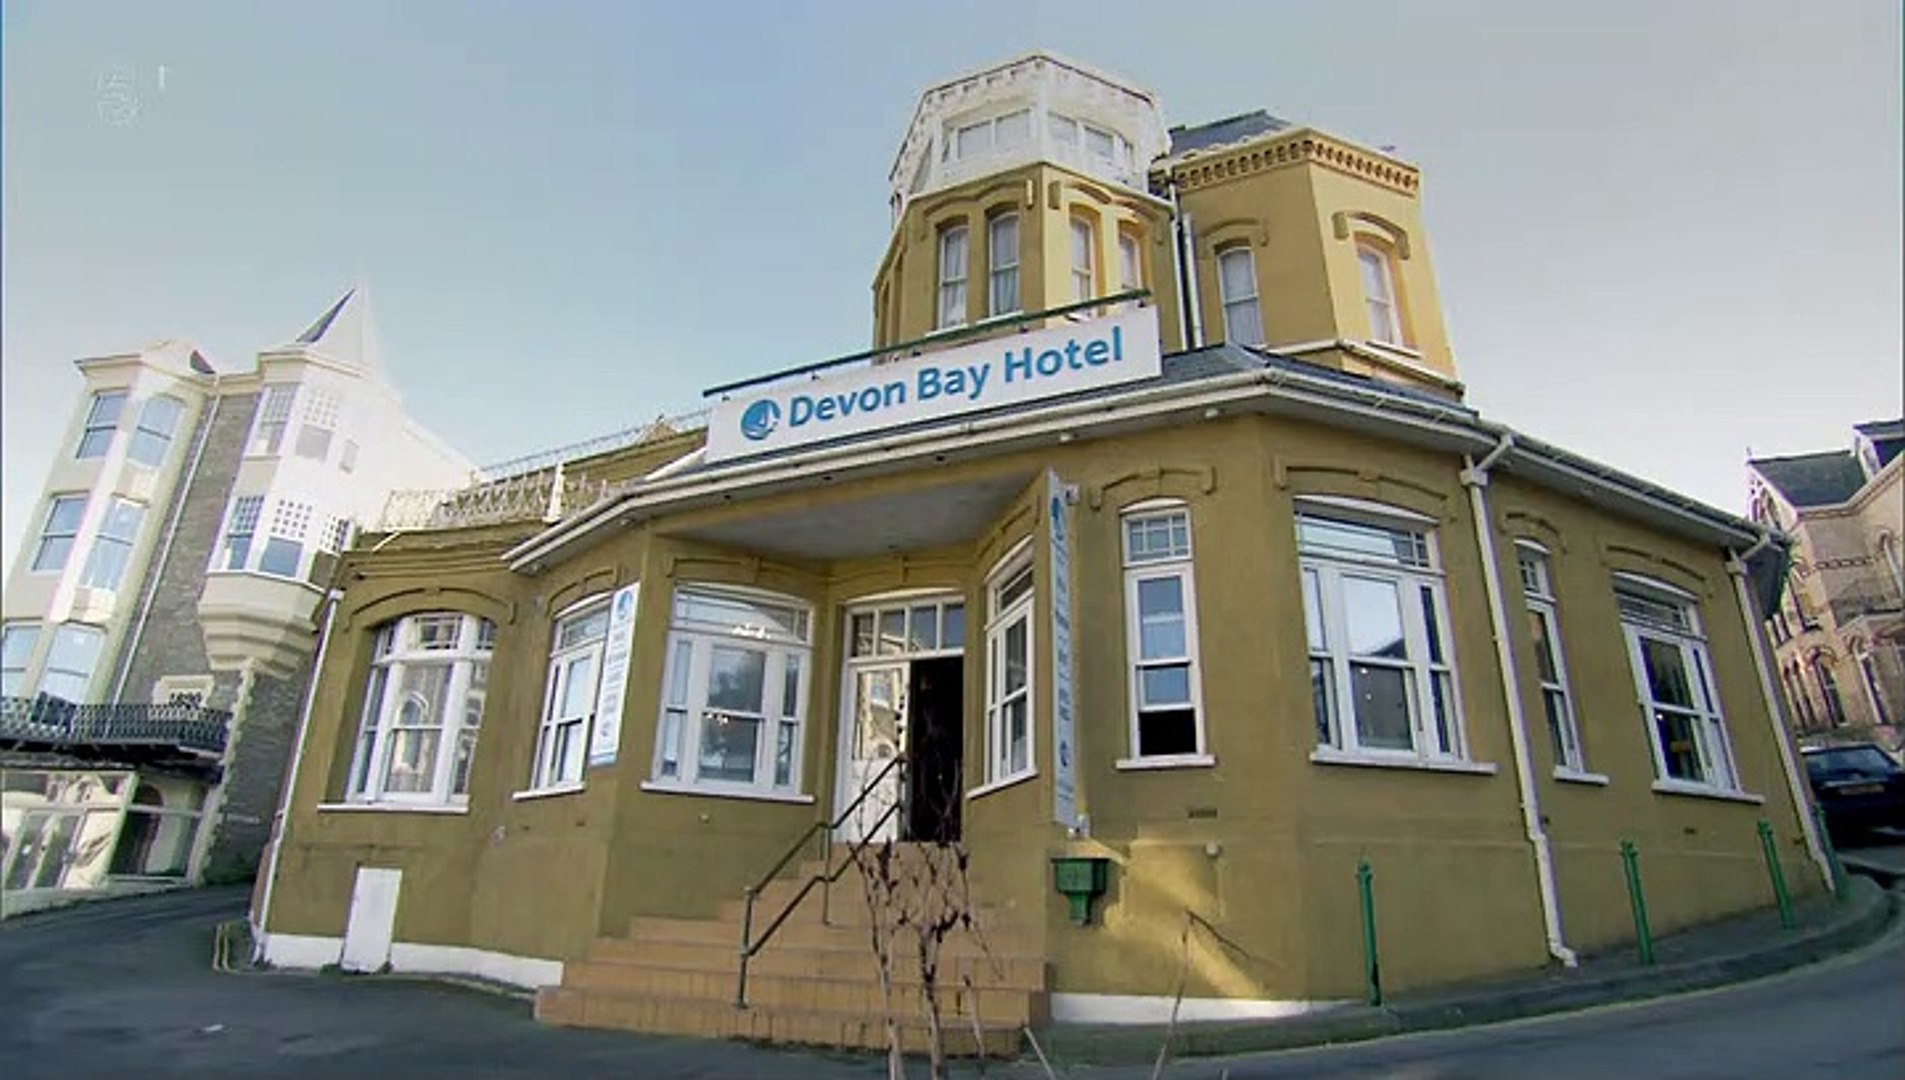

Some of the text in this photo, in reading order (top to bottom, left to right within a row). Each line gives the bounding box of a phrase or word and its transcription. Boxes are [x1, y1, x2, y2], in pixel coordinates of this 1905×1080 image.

[787, 326, 1123, 427] Devon Bay Hotel
